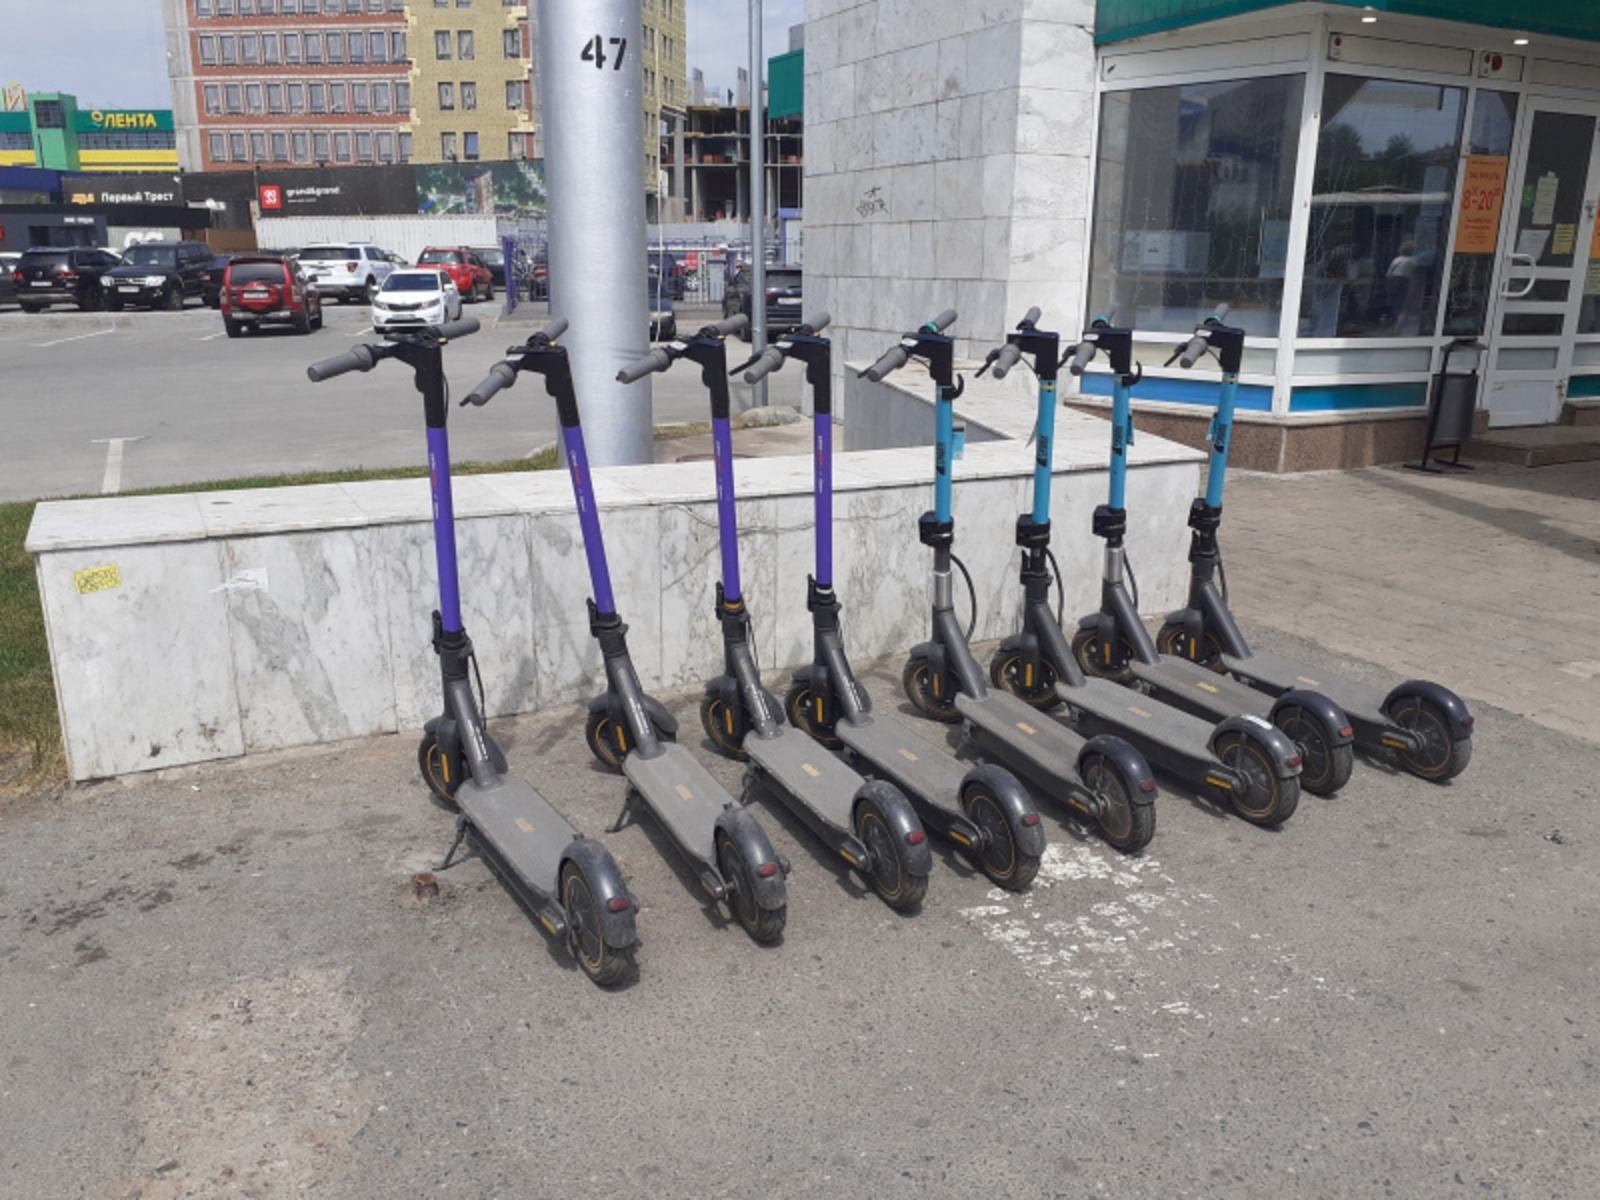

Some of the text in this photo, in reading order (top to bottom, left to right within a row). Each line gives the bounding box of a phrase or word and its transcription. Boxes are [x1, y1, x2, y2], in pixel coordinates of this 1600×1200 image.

[580, 34, 627, 70] 47
[104, 112, 157, 128] ЛЕНТА
[101, 191, 142, 204] Первый
